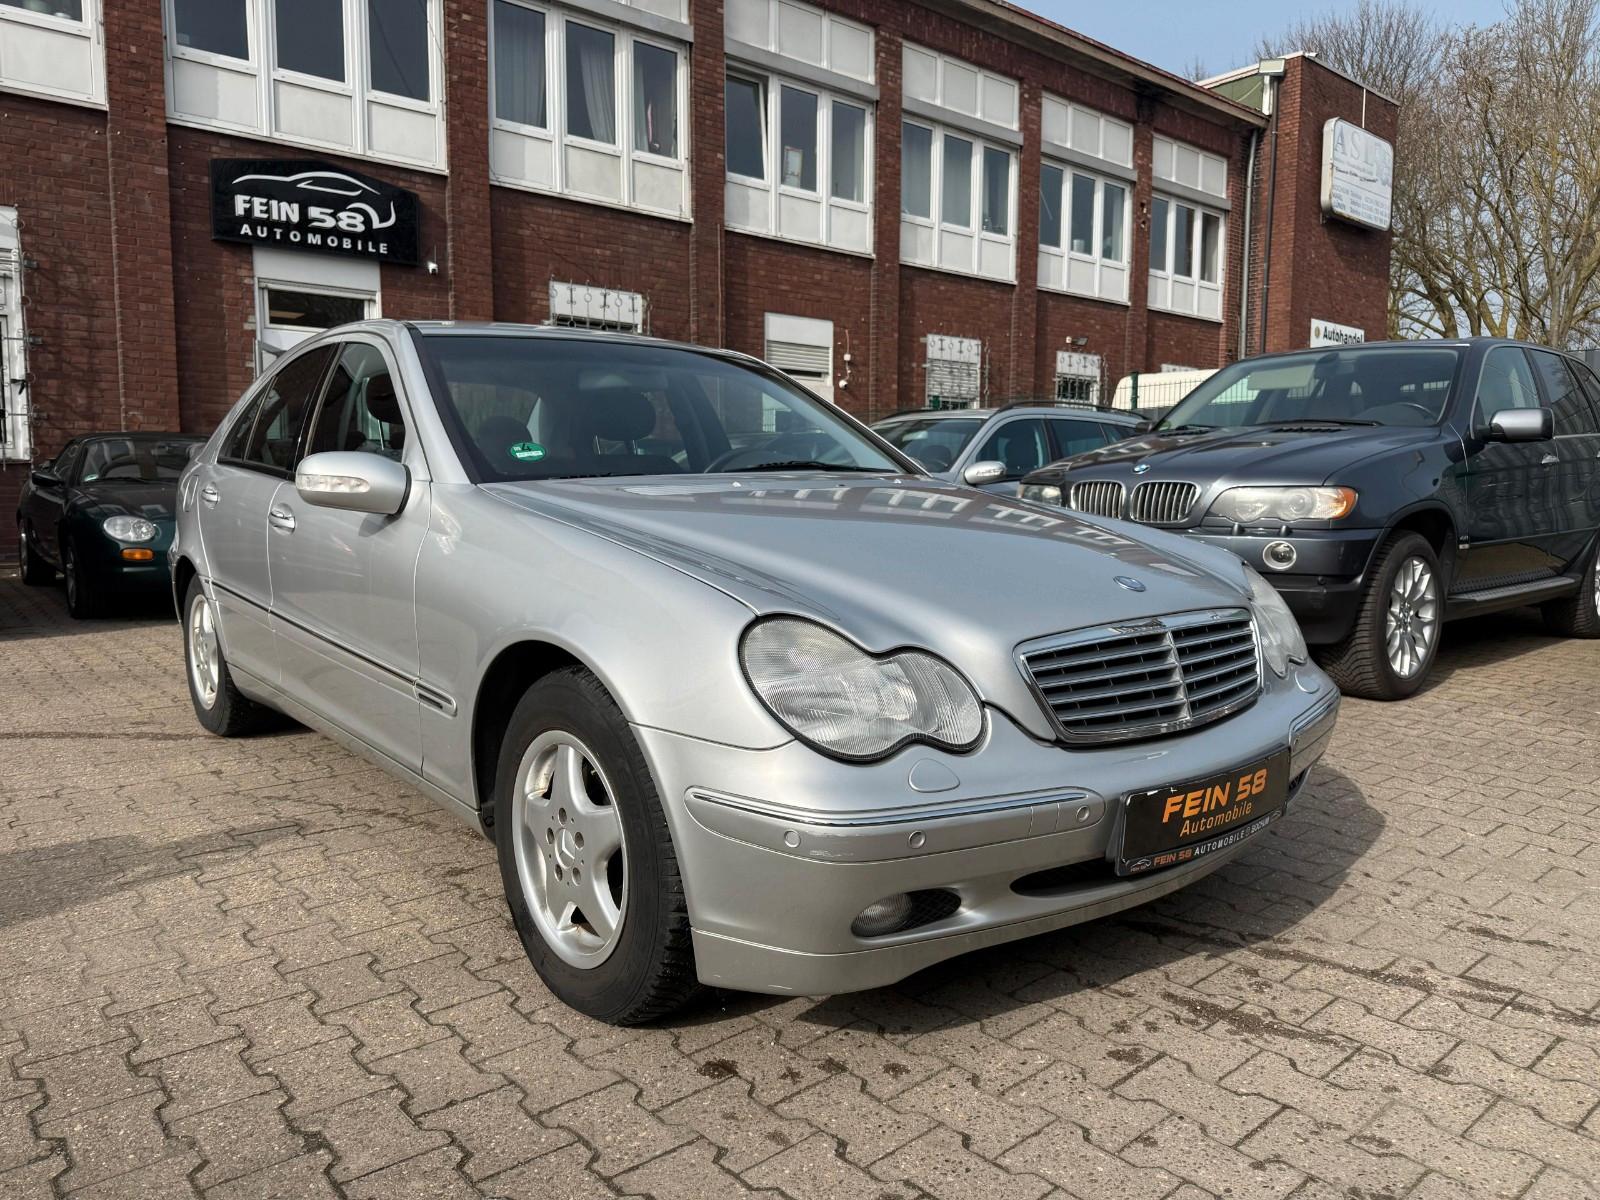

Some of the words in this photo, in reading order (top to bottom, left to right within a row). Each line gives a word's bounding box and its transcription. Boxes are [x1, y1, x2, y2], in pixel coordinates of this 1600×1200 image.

[234, 194, 299, 223] FEIN
[308, 206, 365, 233] 58
[240, 223, 388, 254] AUTOMOBILE
[1323, 326, 1363, 344] Autohandel
[522, 443, 531, 451] 4
[1162, 781, 1231, 824] FEIN
[1235, 768, 1268, 802] 58
[1179, 801, 1252, 838] Automobile
[1153, 853, 1177, 867] FEIN
[1178, 849, 1192, 860] 58
[1193, 830, 1245, 856] AUTOMOBILE
